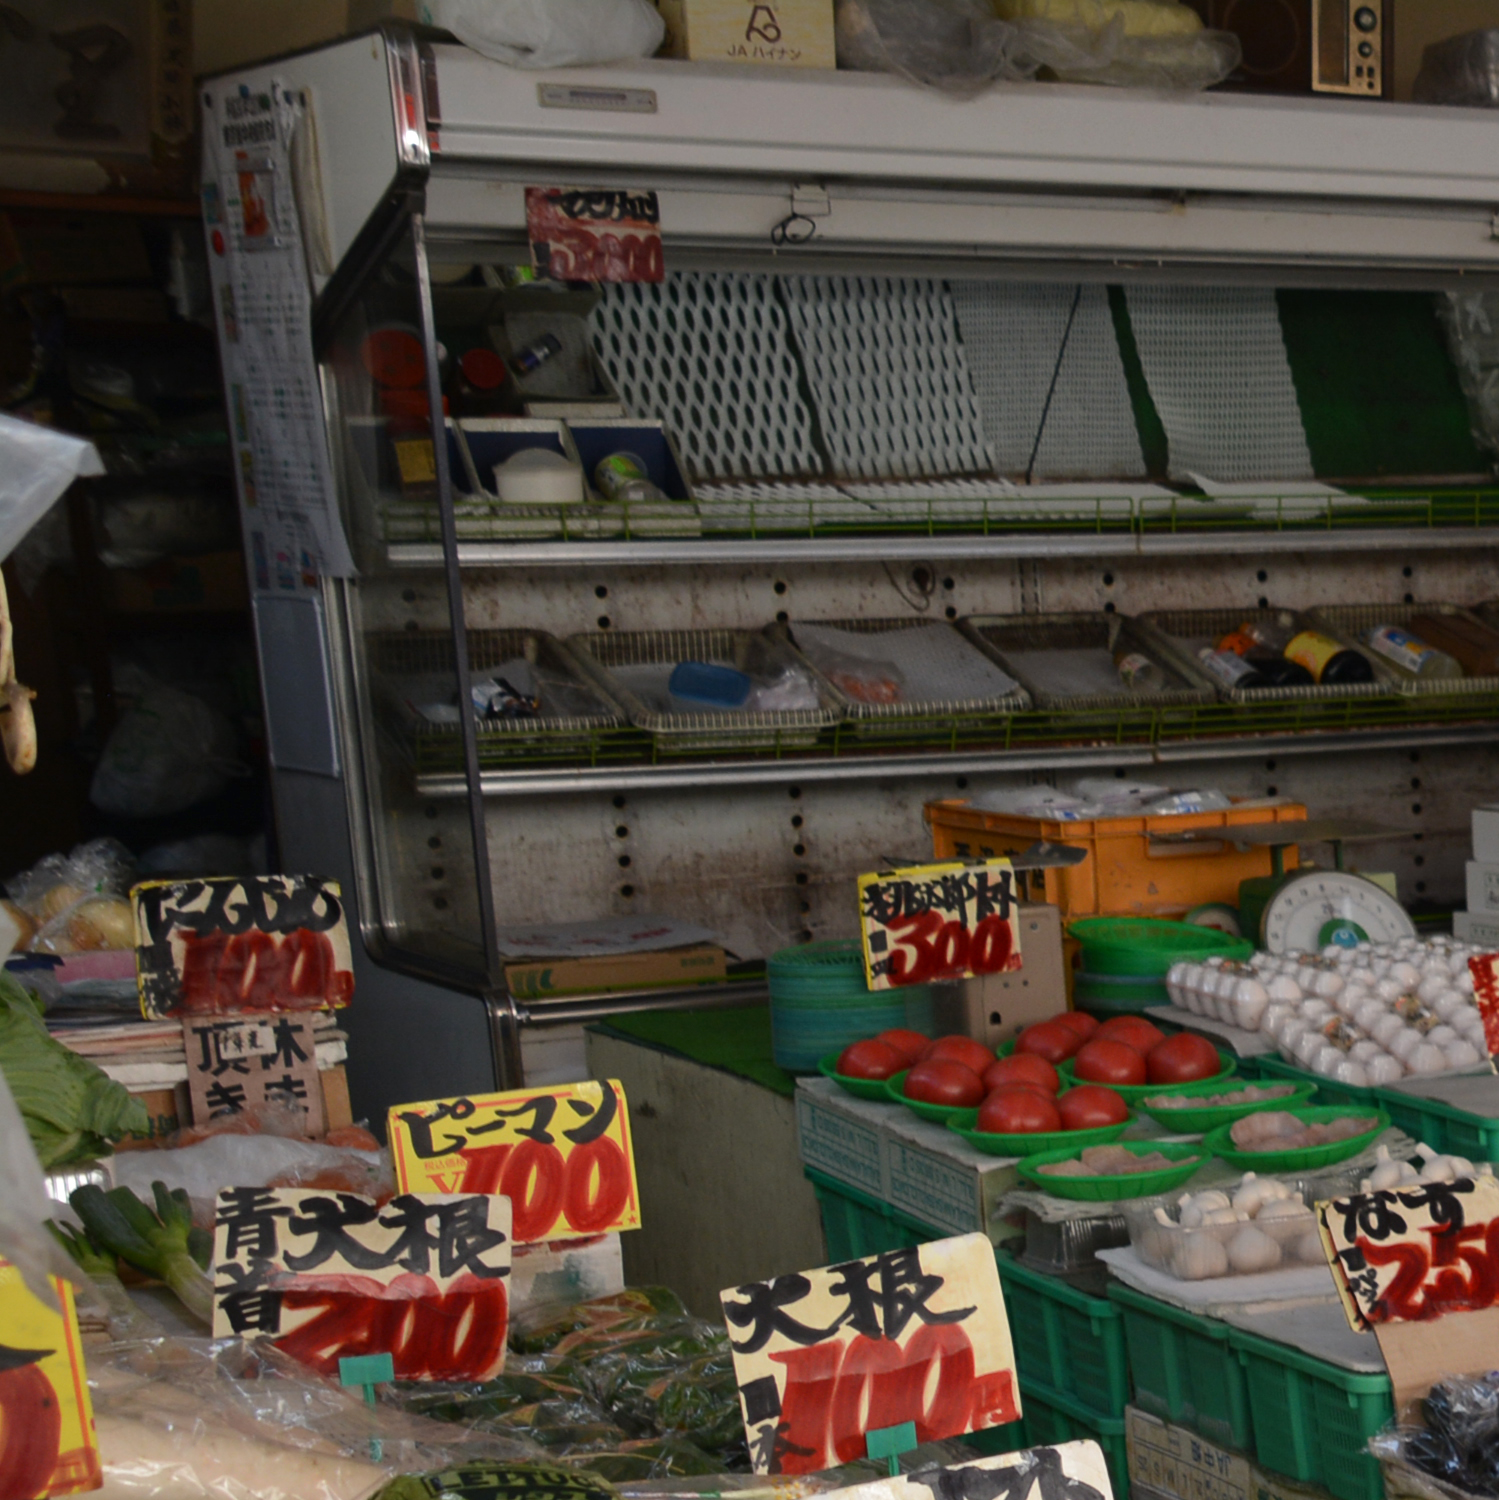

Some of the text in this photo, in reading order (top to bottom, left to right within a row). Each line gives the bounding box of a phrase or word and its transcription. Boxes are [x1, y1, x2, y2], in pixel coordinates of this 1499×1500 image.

[178, 930, 340, 1014] 100
[886, 909, 1013, 989] 300
[400, 1079, 619, 1158] ピーマン
[458, 1137, 627, 1242] 100
[1334, 1177, 1475, 1243] なす
[283, 1192, 511, 1279] 大根
[272, 1271, 508, 1384] 200
[724, 1246, 978, 1354] 大根
